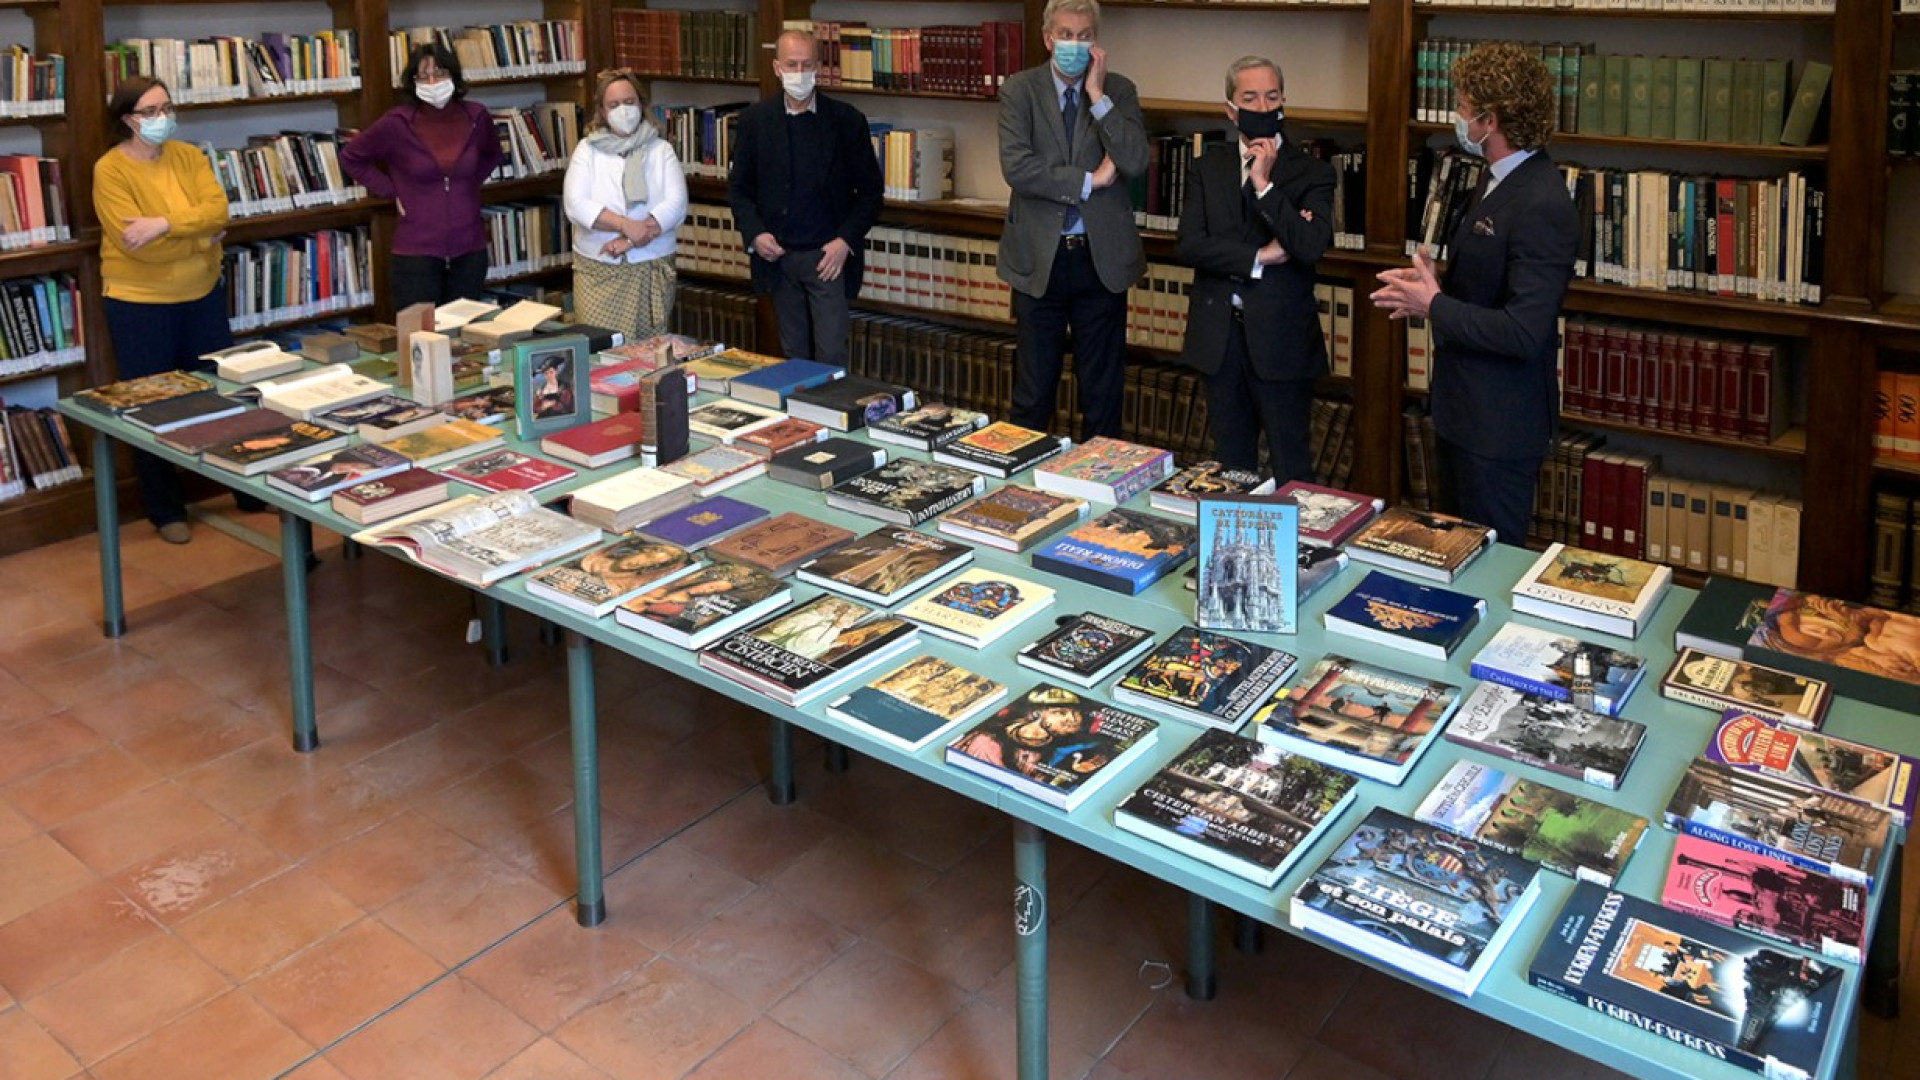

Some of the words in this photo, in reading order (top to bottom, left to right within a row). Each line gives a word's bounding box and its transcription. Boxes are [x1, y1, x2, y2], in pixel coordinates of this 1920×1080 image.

[1212, 507, 1282, 519] CATEDRALES
[1526, 586, 1633, 616] SANTIAGO
[1142, 787, 1227, 824] CISTERCIAN
[1228, 821, 1288, 849] ABBEYS
[1690, 825, 1731, 846] ALONG
[1731, 841, 1761, 857] LOST
[1318, 882, 1343, 899] et
[1346, 894, 1388, 916] son
[1388, 910, 1467, 947] palais
[1348, 876, 1460, 927] LIÈGE
